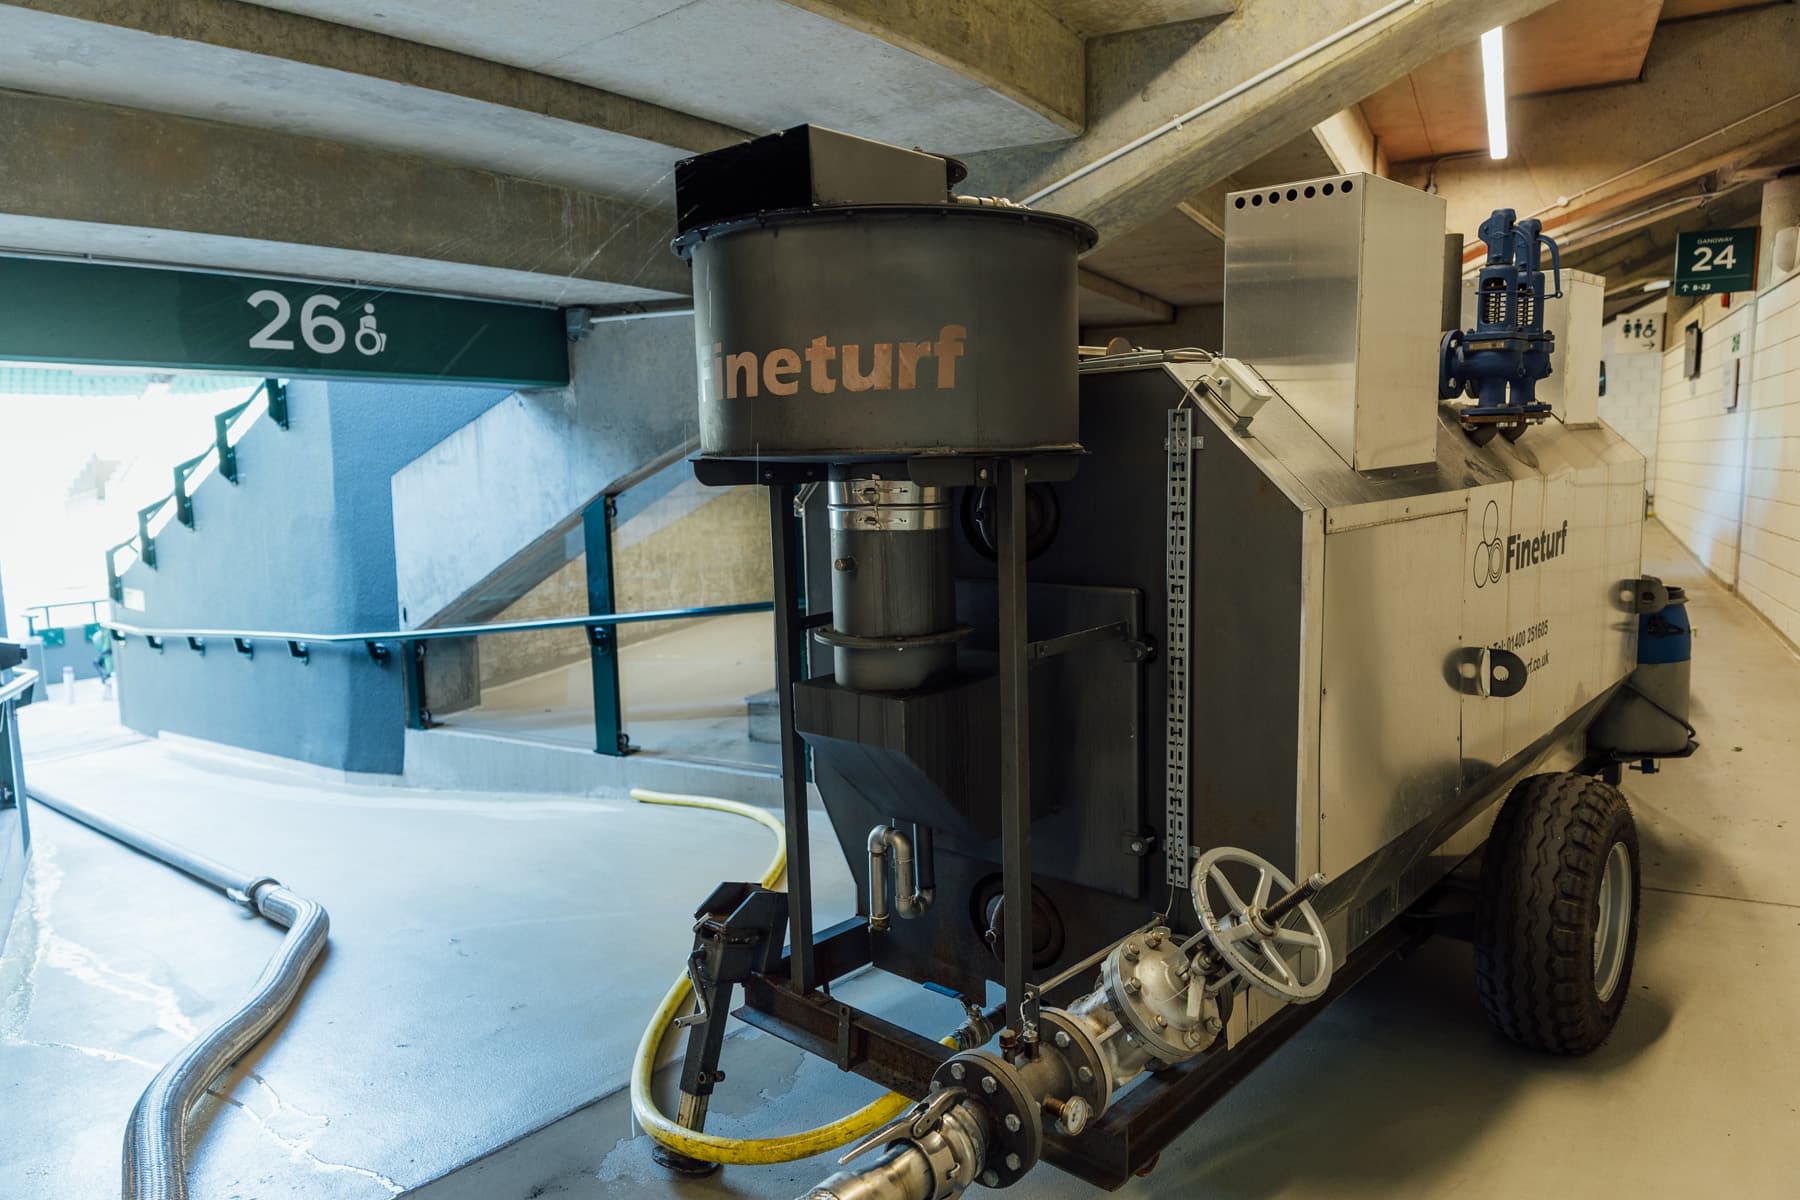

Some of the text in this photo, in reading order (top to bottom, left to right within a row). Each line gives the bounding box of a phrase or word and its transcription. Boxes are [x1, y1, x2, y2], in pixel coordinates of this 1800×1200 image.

[1691, 244, 1737, 272] 24
[247, 289, 346, 354] 26
[1505, 519, 1568, 574] Fineturf
